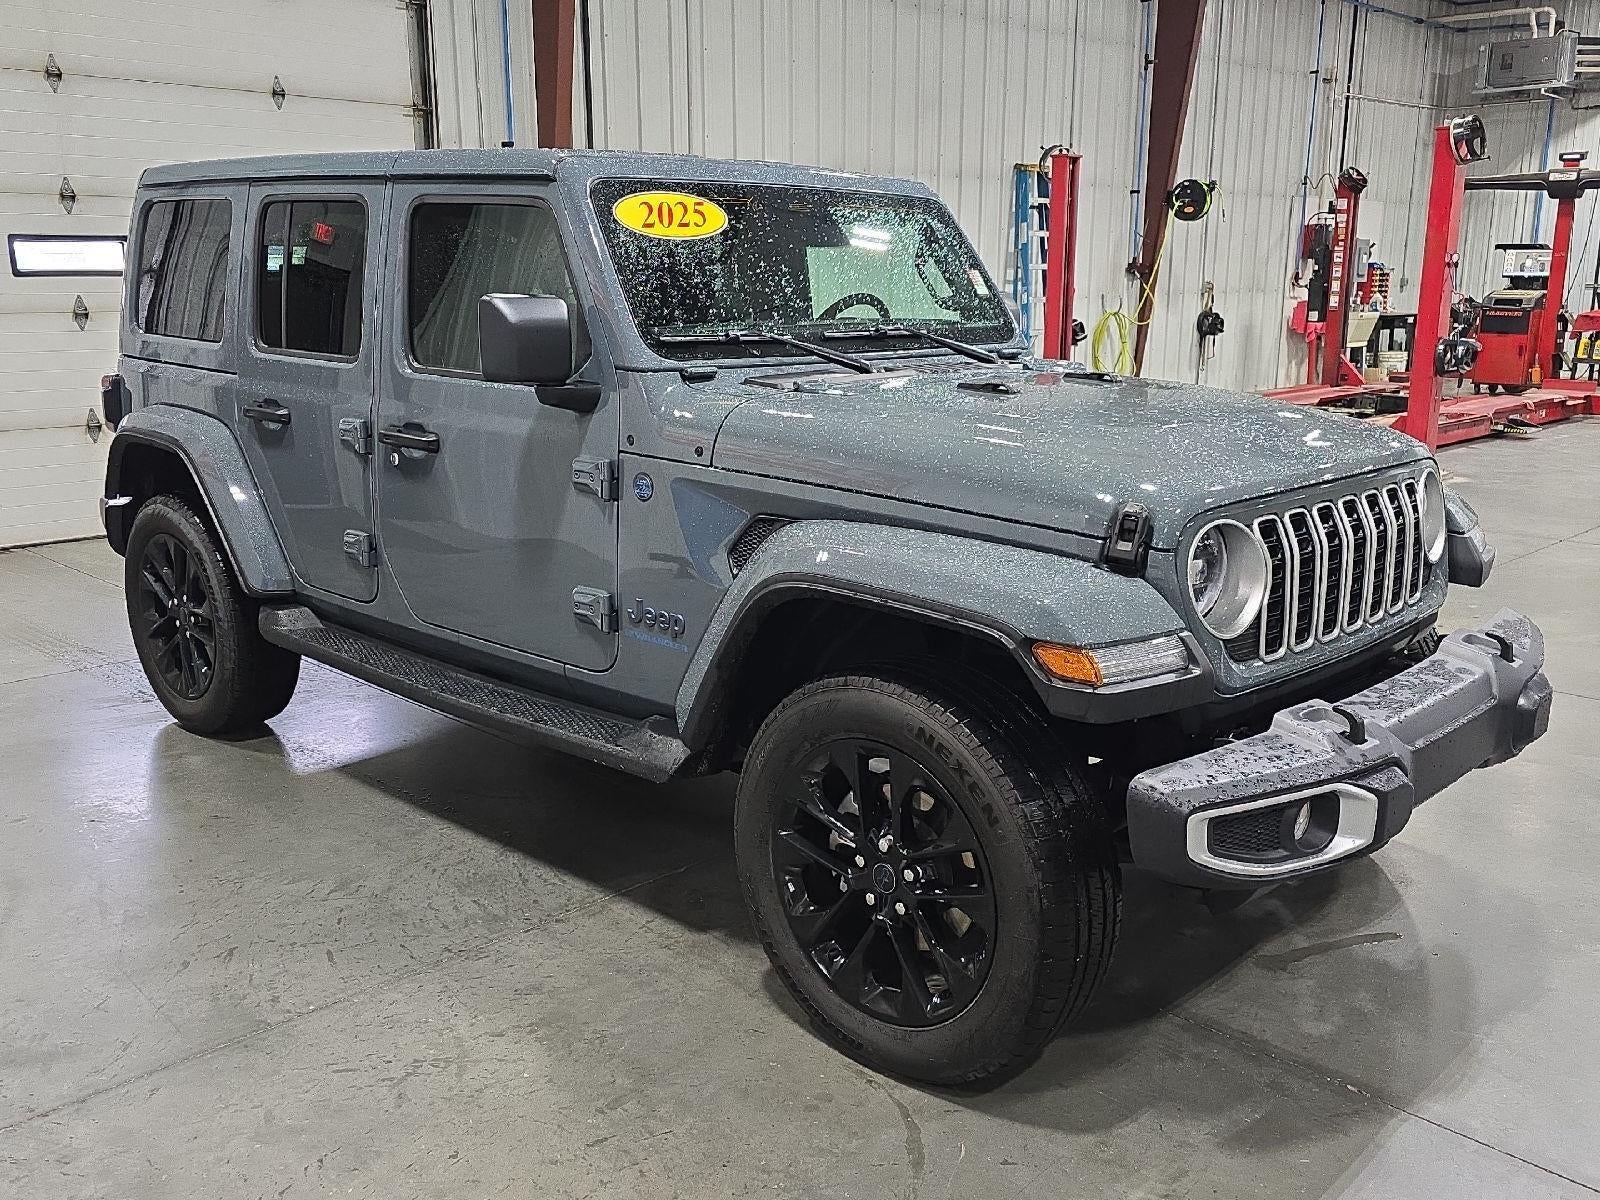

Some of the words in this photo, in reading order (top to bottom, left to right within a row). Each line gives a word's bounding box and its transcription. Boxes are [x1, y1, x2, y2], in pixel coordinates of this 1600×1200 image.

[639, 201, 707, 229] 2025
[627, 597, 686, 638] Jeep
[914, 725, 999, 828] NEXEN
